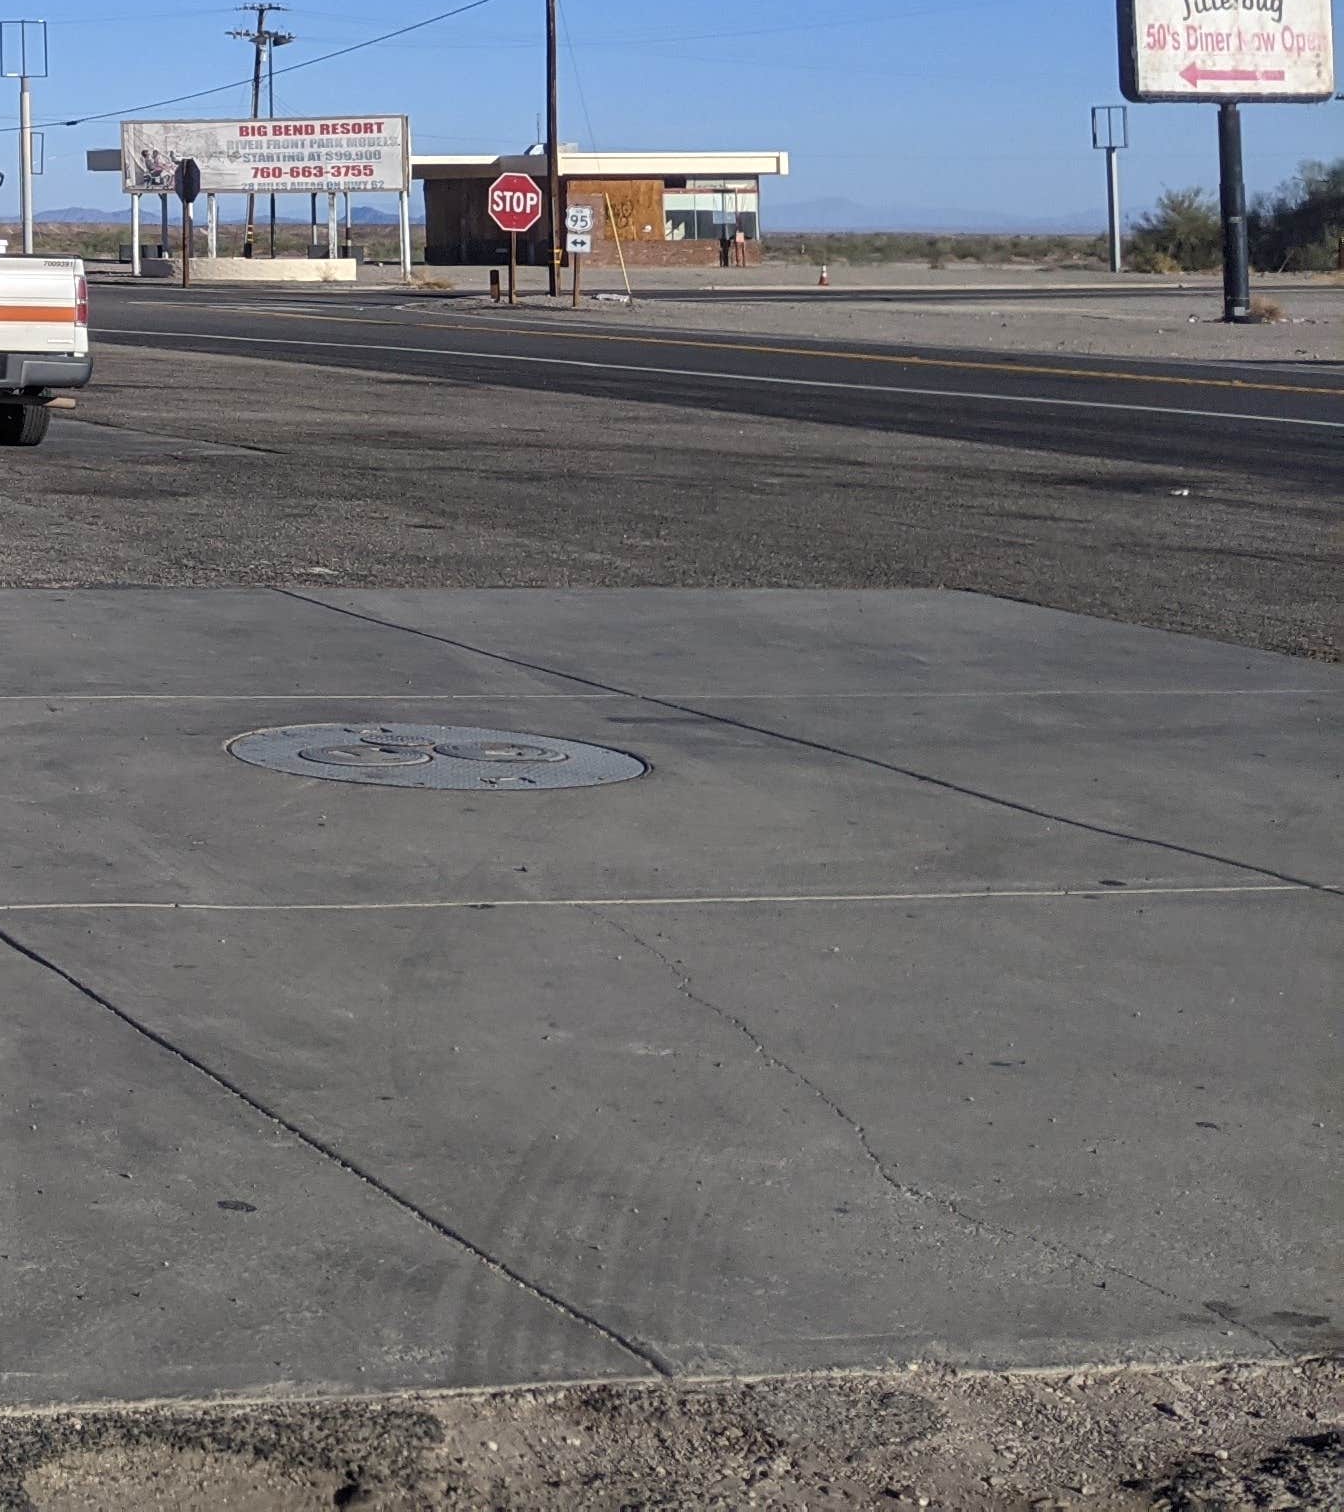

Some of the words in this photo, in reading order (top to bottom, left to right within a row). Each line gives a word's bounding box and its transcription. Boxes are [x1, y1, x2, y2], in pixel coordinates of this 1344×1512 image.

[1145, 23, 1181, 52] 50's
[1186, 24, 1232, 52] Diner
[238, 125, 268, 137] BIG
[271, 123, 315, 136] BEND
[319, 121, 385, 135] RESORT
[266, 138, 308, 150] FRONT
[310, 137, 344, 149] PARK
[242, 152, 305, 163] STARTING
[307, 151, 322, 162] AT
[250, 164, 375, 179] 760-663-3755
[492, 190, 538, 214] STOP
[570, 214, 589, 229] 95
